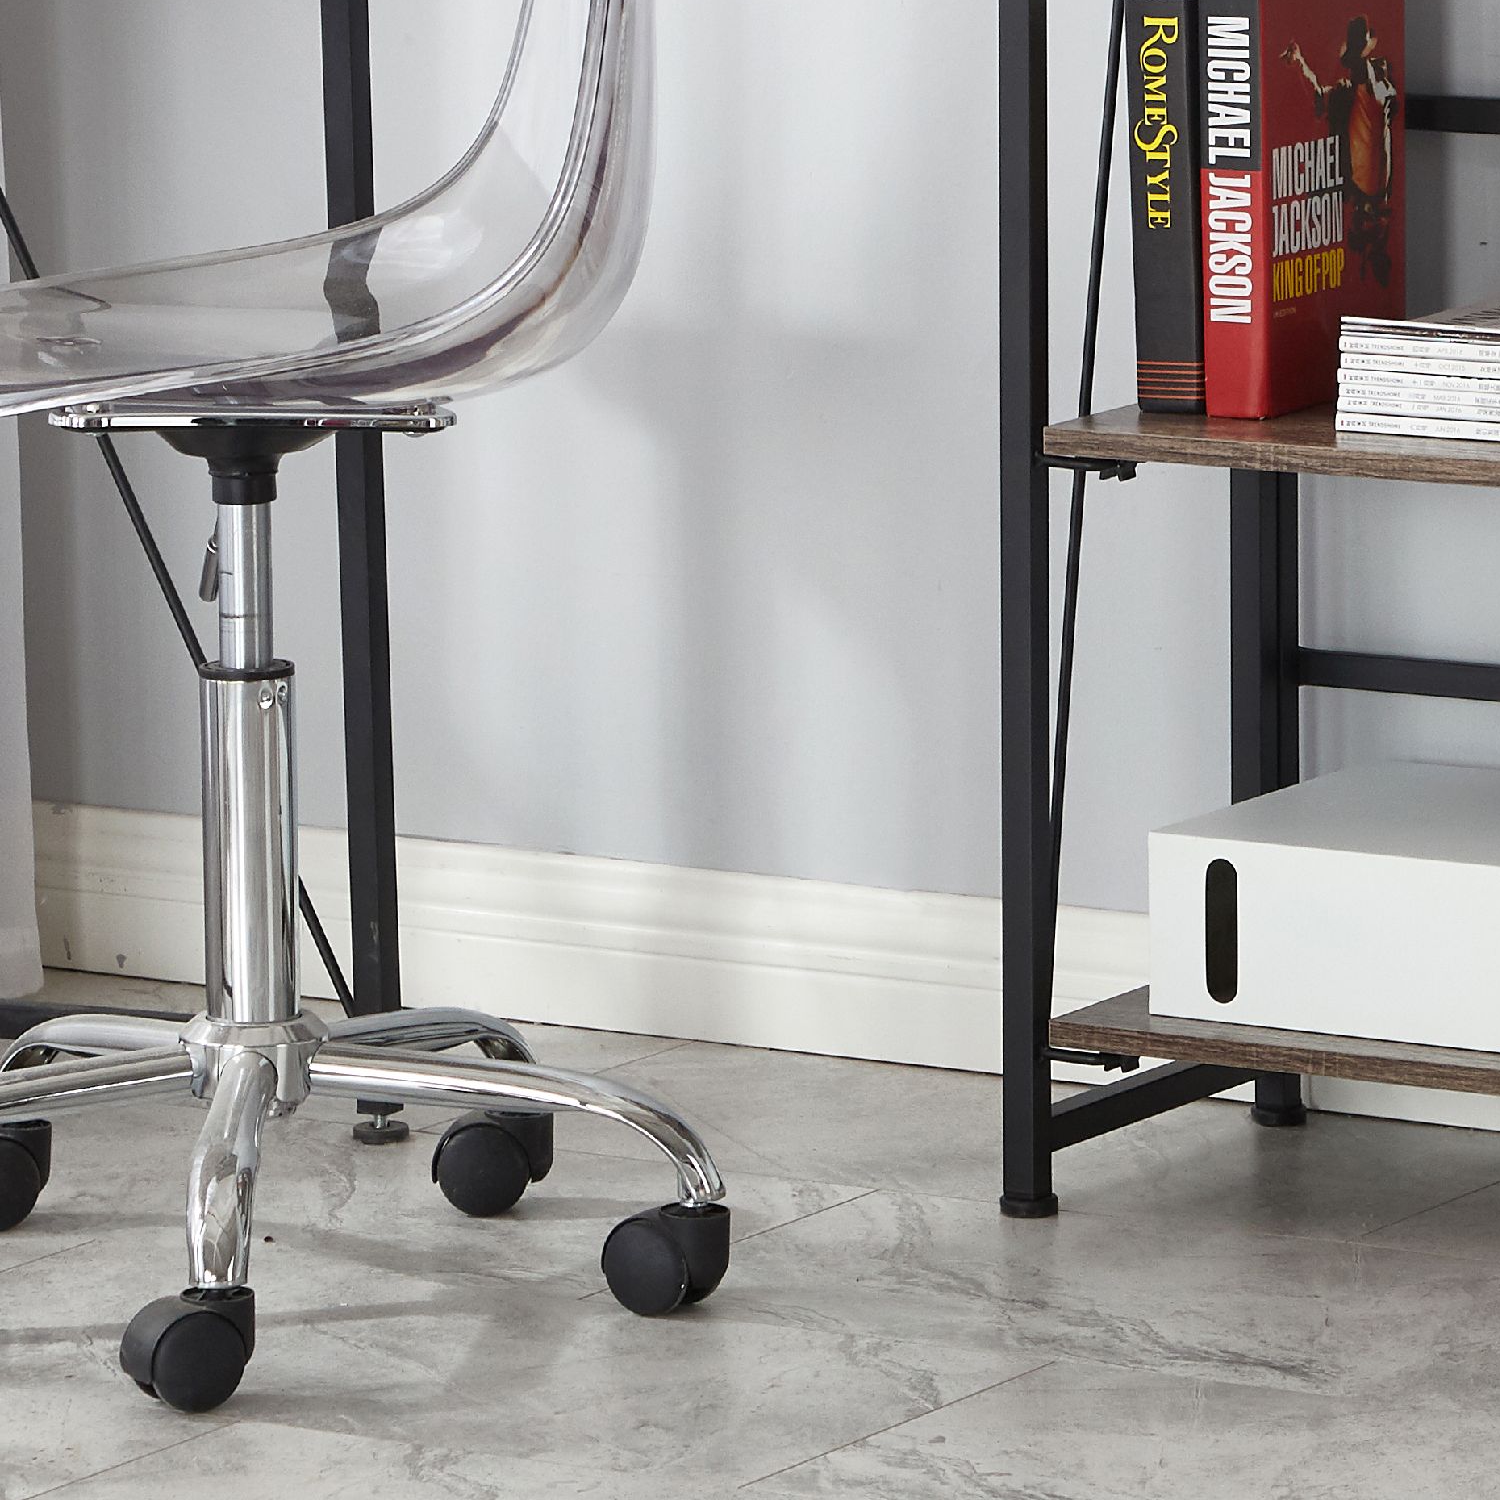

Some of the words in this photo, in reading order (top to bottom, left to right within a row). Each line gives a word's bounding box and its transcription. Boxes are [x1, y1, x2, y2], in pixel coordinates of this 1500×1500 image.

[1206, 15, 1251, 165] MICHAEL
[1272, 134, 1344, 200] MICHAEL
[1207, 172, 1252, 325] JACKSON
[1271, 191, 1343, 258] JACKSON
